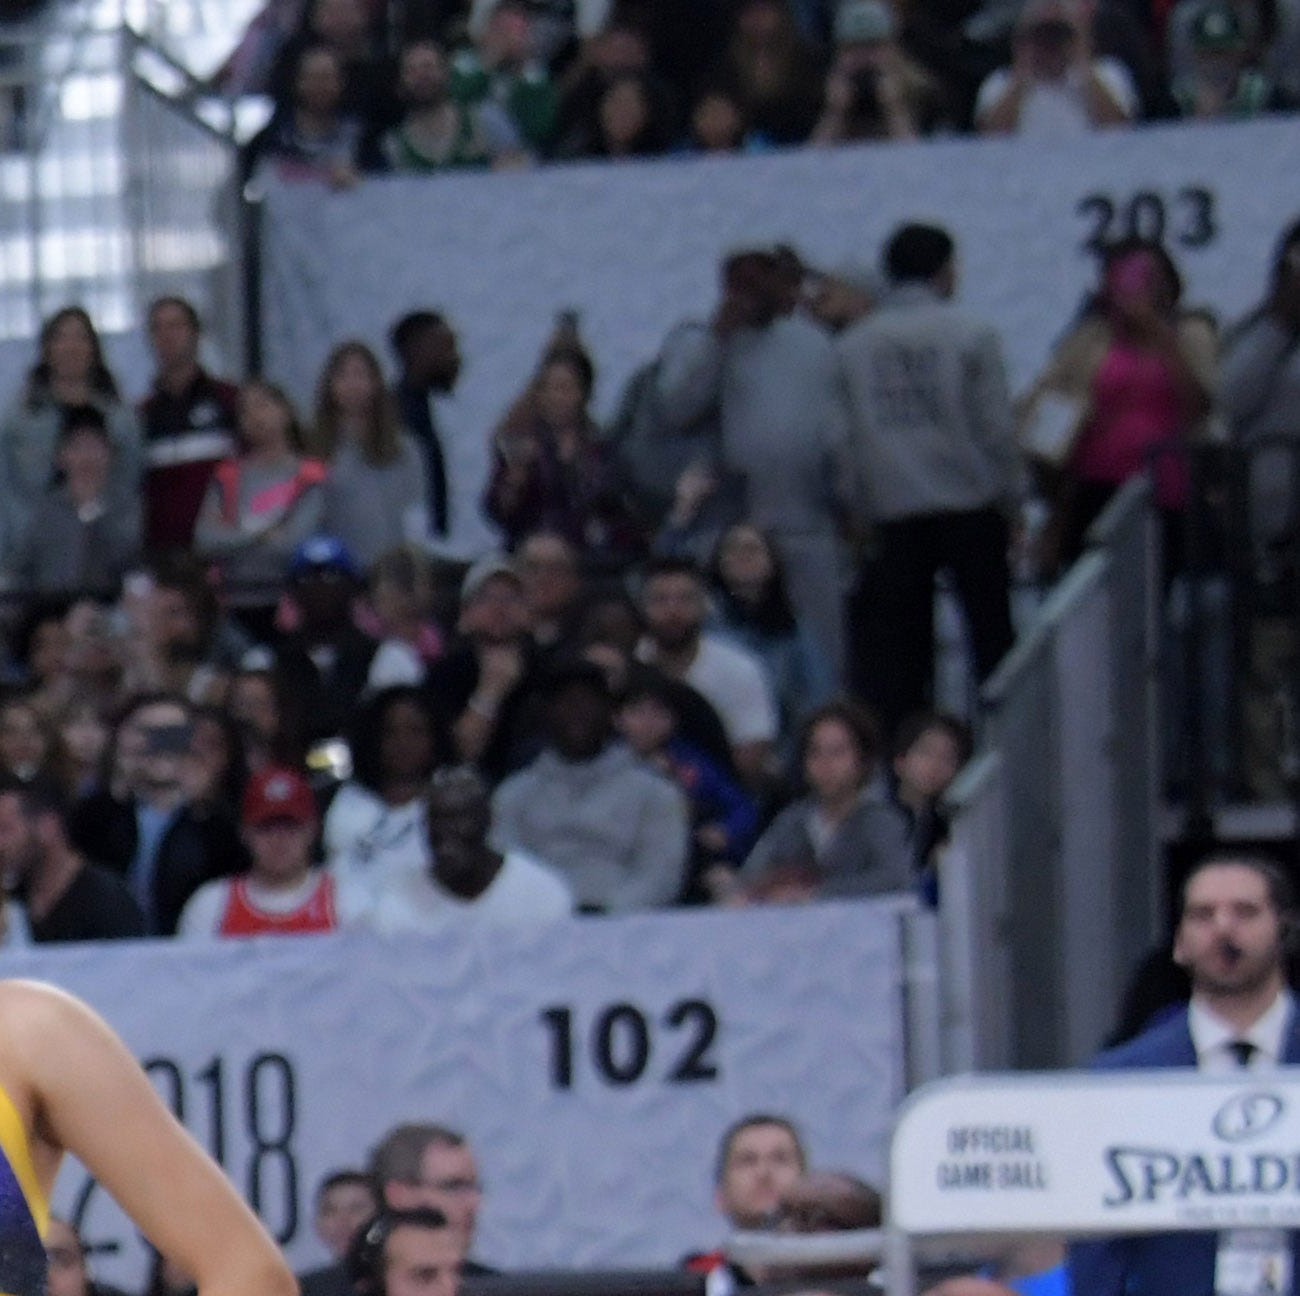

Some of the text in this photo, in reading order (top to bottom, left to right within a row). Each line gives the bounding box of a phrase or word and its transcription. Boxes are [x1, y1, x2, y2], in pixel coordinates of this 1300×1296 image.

[1073, 187, 1217, 260] 203
[538, 998, 722, 1092] 102
[946, 1126, 1035, 1155] OFFICIAL
[936, 1160, 1048, 1192] GAME BALL
